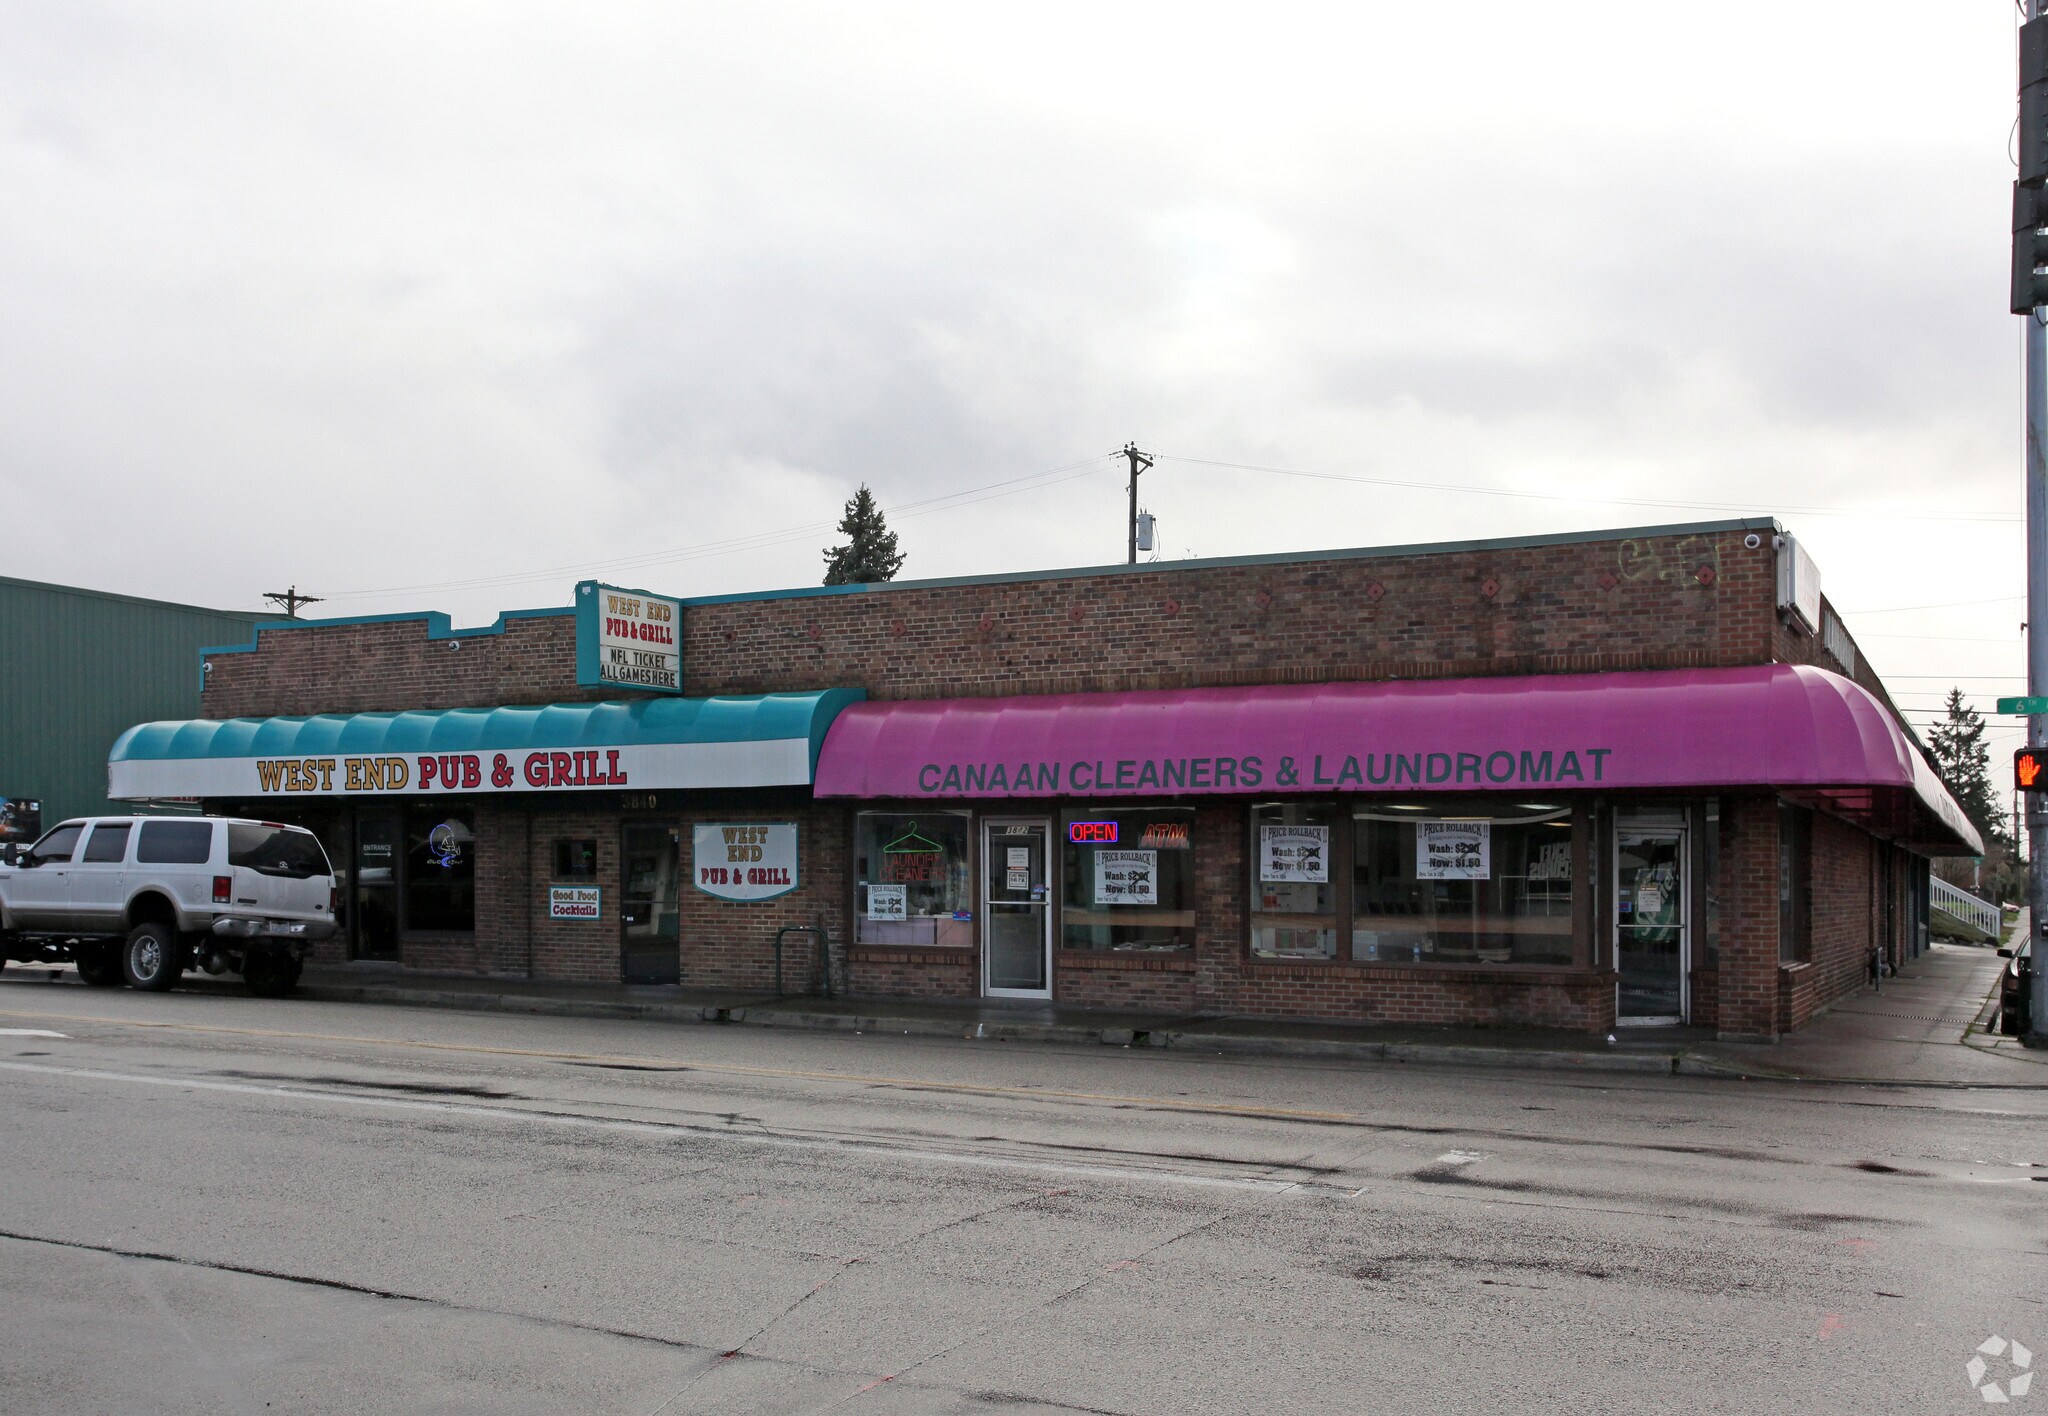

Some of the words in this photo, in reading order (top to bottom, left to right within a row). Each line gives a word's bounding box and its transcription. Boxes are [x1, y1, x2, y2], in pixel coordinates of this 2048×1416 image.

[607, 595, 640, 617] WEST
[647, 602, 671, 622] END
[606, 617, 628, 638] PUB
[630, 621, 638, 640] &
[639, 623, 672, 644] GRILL
[611, 649, 628, 664] NFL
[633, 652, 666, 667] TICKET
[600, 664, 618, 679] ALL
[620, 667, 651, 682] GAMES
[652, 671, 675, 686] HERE
[257, 759, 335, 791] WEST
[345, 757, 409, 790] END
[418, 755, 481, 790] PUB
[491, 753, 514, 788] &
[524, 750, 628, 788] GRILL
[918, 762, 1060, 792] CANAAN
[1068, 756, 1263, 791] CLEANERS
[1275, 756, 1299, 786] &
[1313, 749, 1612, 785] LAUNDROMAT
[722, 827, 768, 844] WEST
[1072, 823, 1117, 841] OPEN
[1141, 824, 1189, 847] ATM
[1268, 827, 1287, 840] PRICE
[1288, 827, 1322, 842] ROLLBACK
[1424, 823, 1445, 837] PRICE
[1446, 823, 1482, 837] ROLLBACK
[727, 845, 763, 862] END
[1271, 847, 1295, 857] Wash:
[1428, 844, 1453, 853] Wash:
[1101, 852, 1119, 865] PRICE
[1120, 852, 1151, 866] ROLLBACK
[1272, 861, 1294, 870] Now:
[1296, 861, 1320, 871] $1.50
[1429, 858, 1453, 867] Now:
[1455, 858, 1480, 868] $1.50
[701, 868, 728, 885] PUB
[733, 868, 742, 885] &
[747, 868, 790, 885] GRILL
[880, 867, 947, 881] CLEANERS
[1105, 871, 1126, 880] Wash:
[552, 890, 574, 901] Good
[578, 890, 597, 901] Food
[1105, 884, 1126, 894] Now:
[1128, 885, 1149, 895] $1.50
[553, 905, 597, 915] Cocktails
